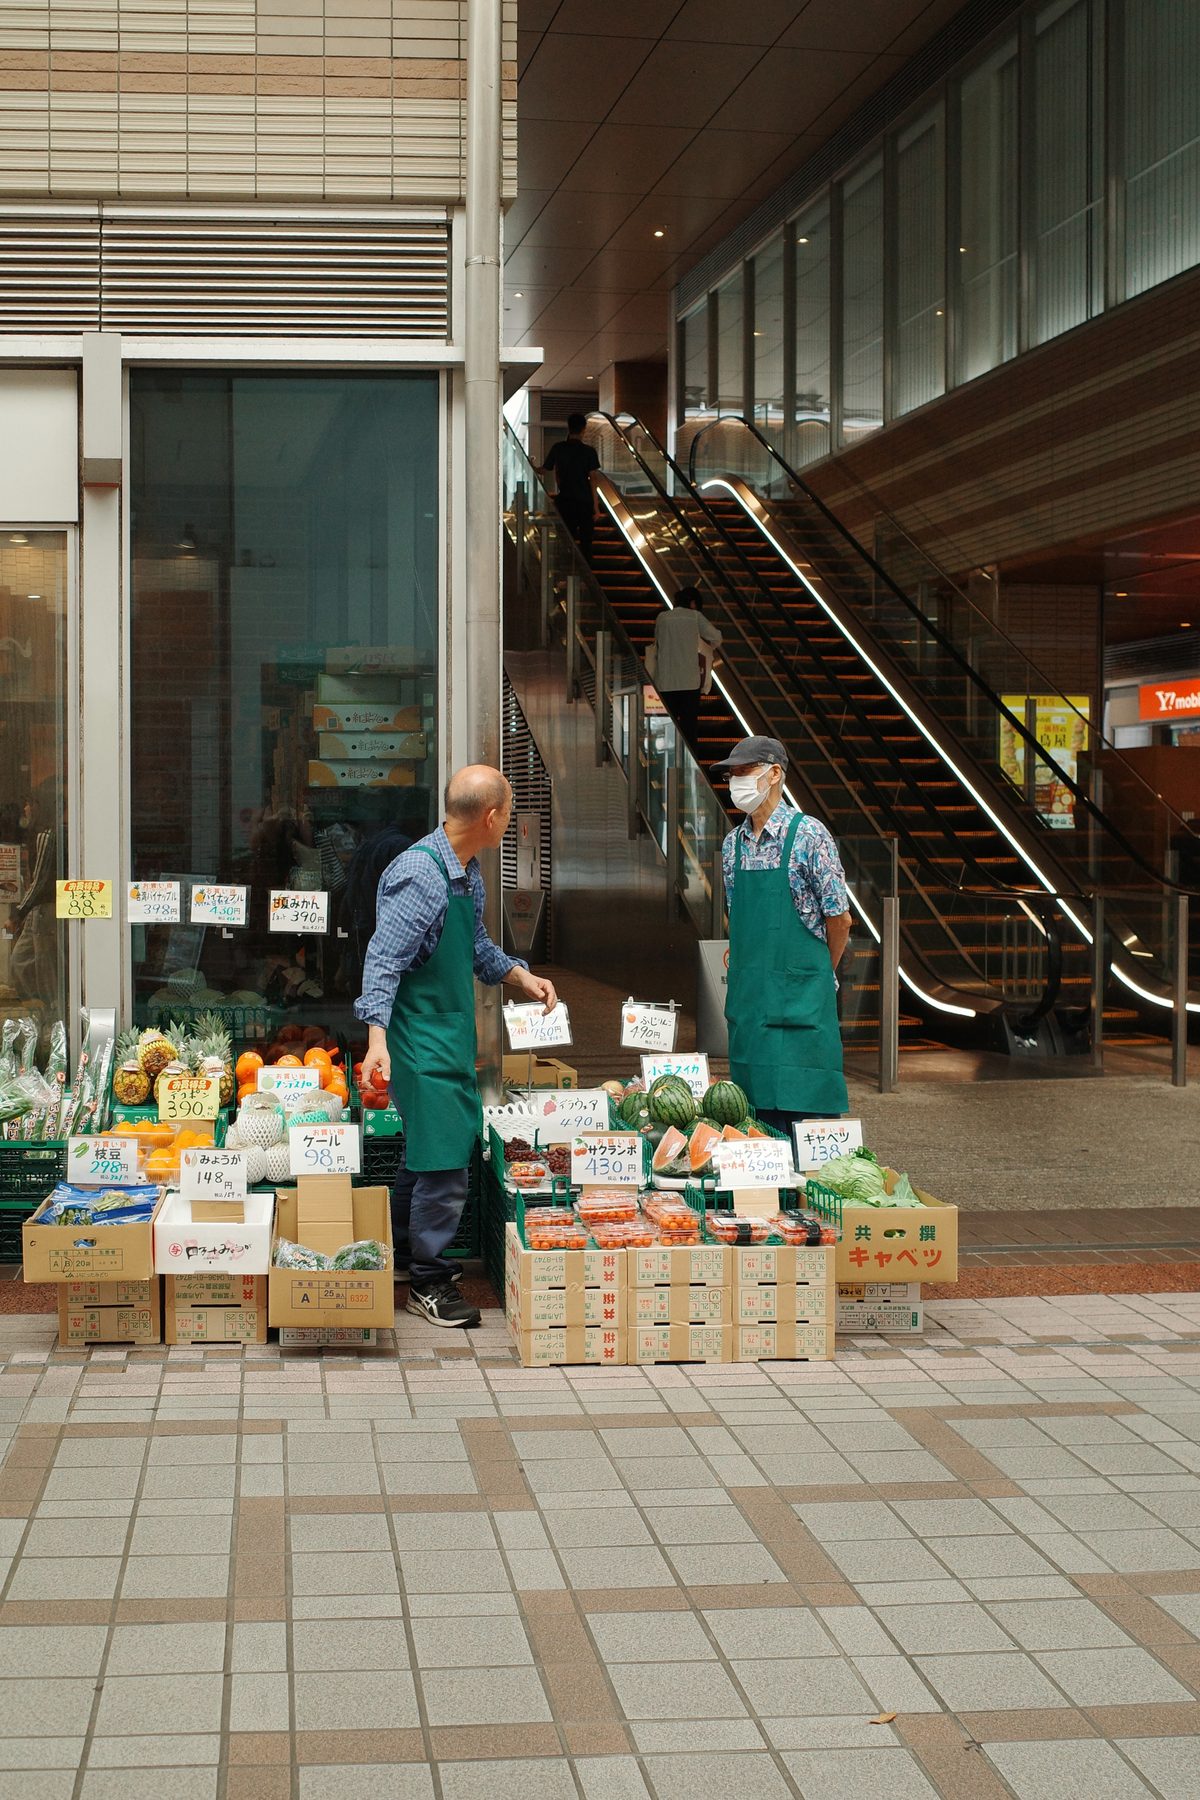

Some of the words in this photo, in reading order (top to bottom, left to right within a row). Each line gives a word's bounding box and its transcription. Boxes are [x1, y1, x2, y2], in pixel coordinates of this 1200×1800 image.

[144, 903, 178, 915] 398円
[273, 897, 320, 910] 甘夏みかん
[290, 911, 325, 923] 390円
[630, 1025, 660, 1039] 490円
[647, 1064, 700, 1077] 小玉スイカ
[171, 1080, 208, 1090] お買得品
[170, 1090, 210, 1100] デコポン
[560, 1116, 604, 1130] 490円
[312, 1128, 345, 1136] お買い得
[303, 1135, 341, 1148] ケール
[597, 1138, 636, 1146] お買い得
[803, 1132, 849, 1145] キャベツ
[94, 1148, 121, 1160] 枝豆
[588, 1145, 637, 1156] サクランボ
[734, 1148, 783, 1158] サクランボ
[199, 1154, 242, 1165] みょうが
[304, 1148, 346, 1167] 98円
[90, 1160, 129, 1174] 298円
[584, 1157, 637, 1175] 430円
[849, 1247, 942, 1268] キャベツ
[301, 1293, 310, 1303] A
